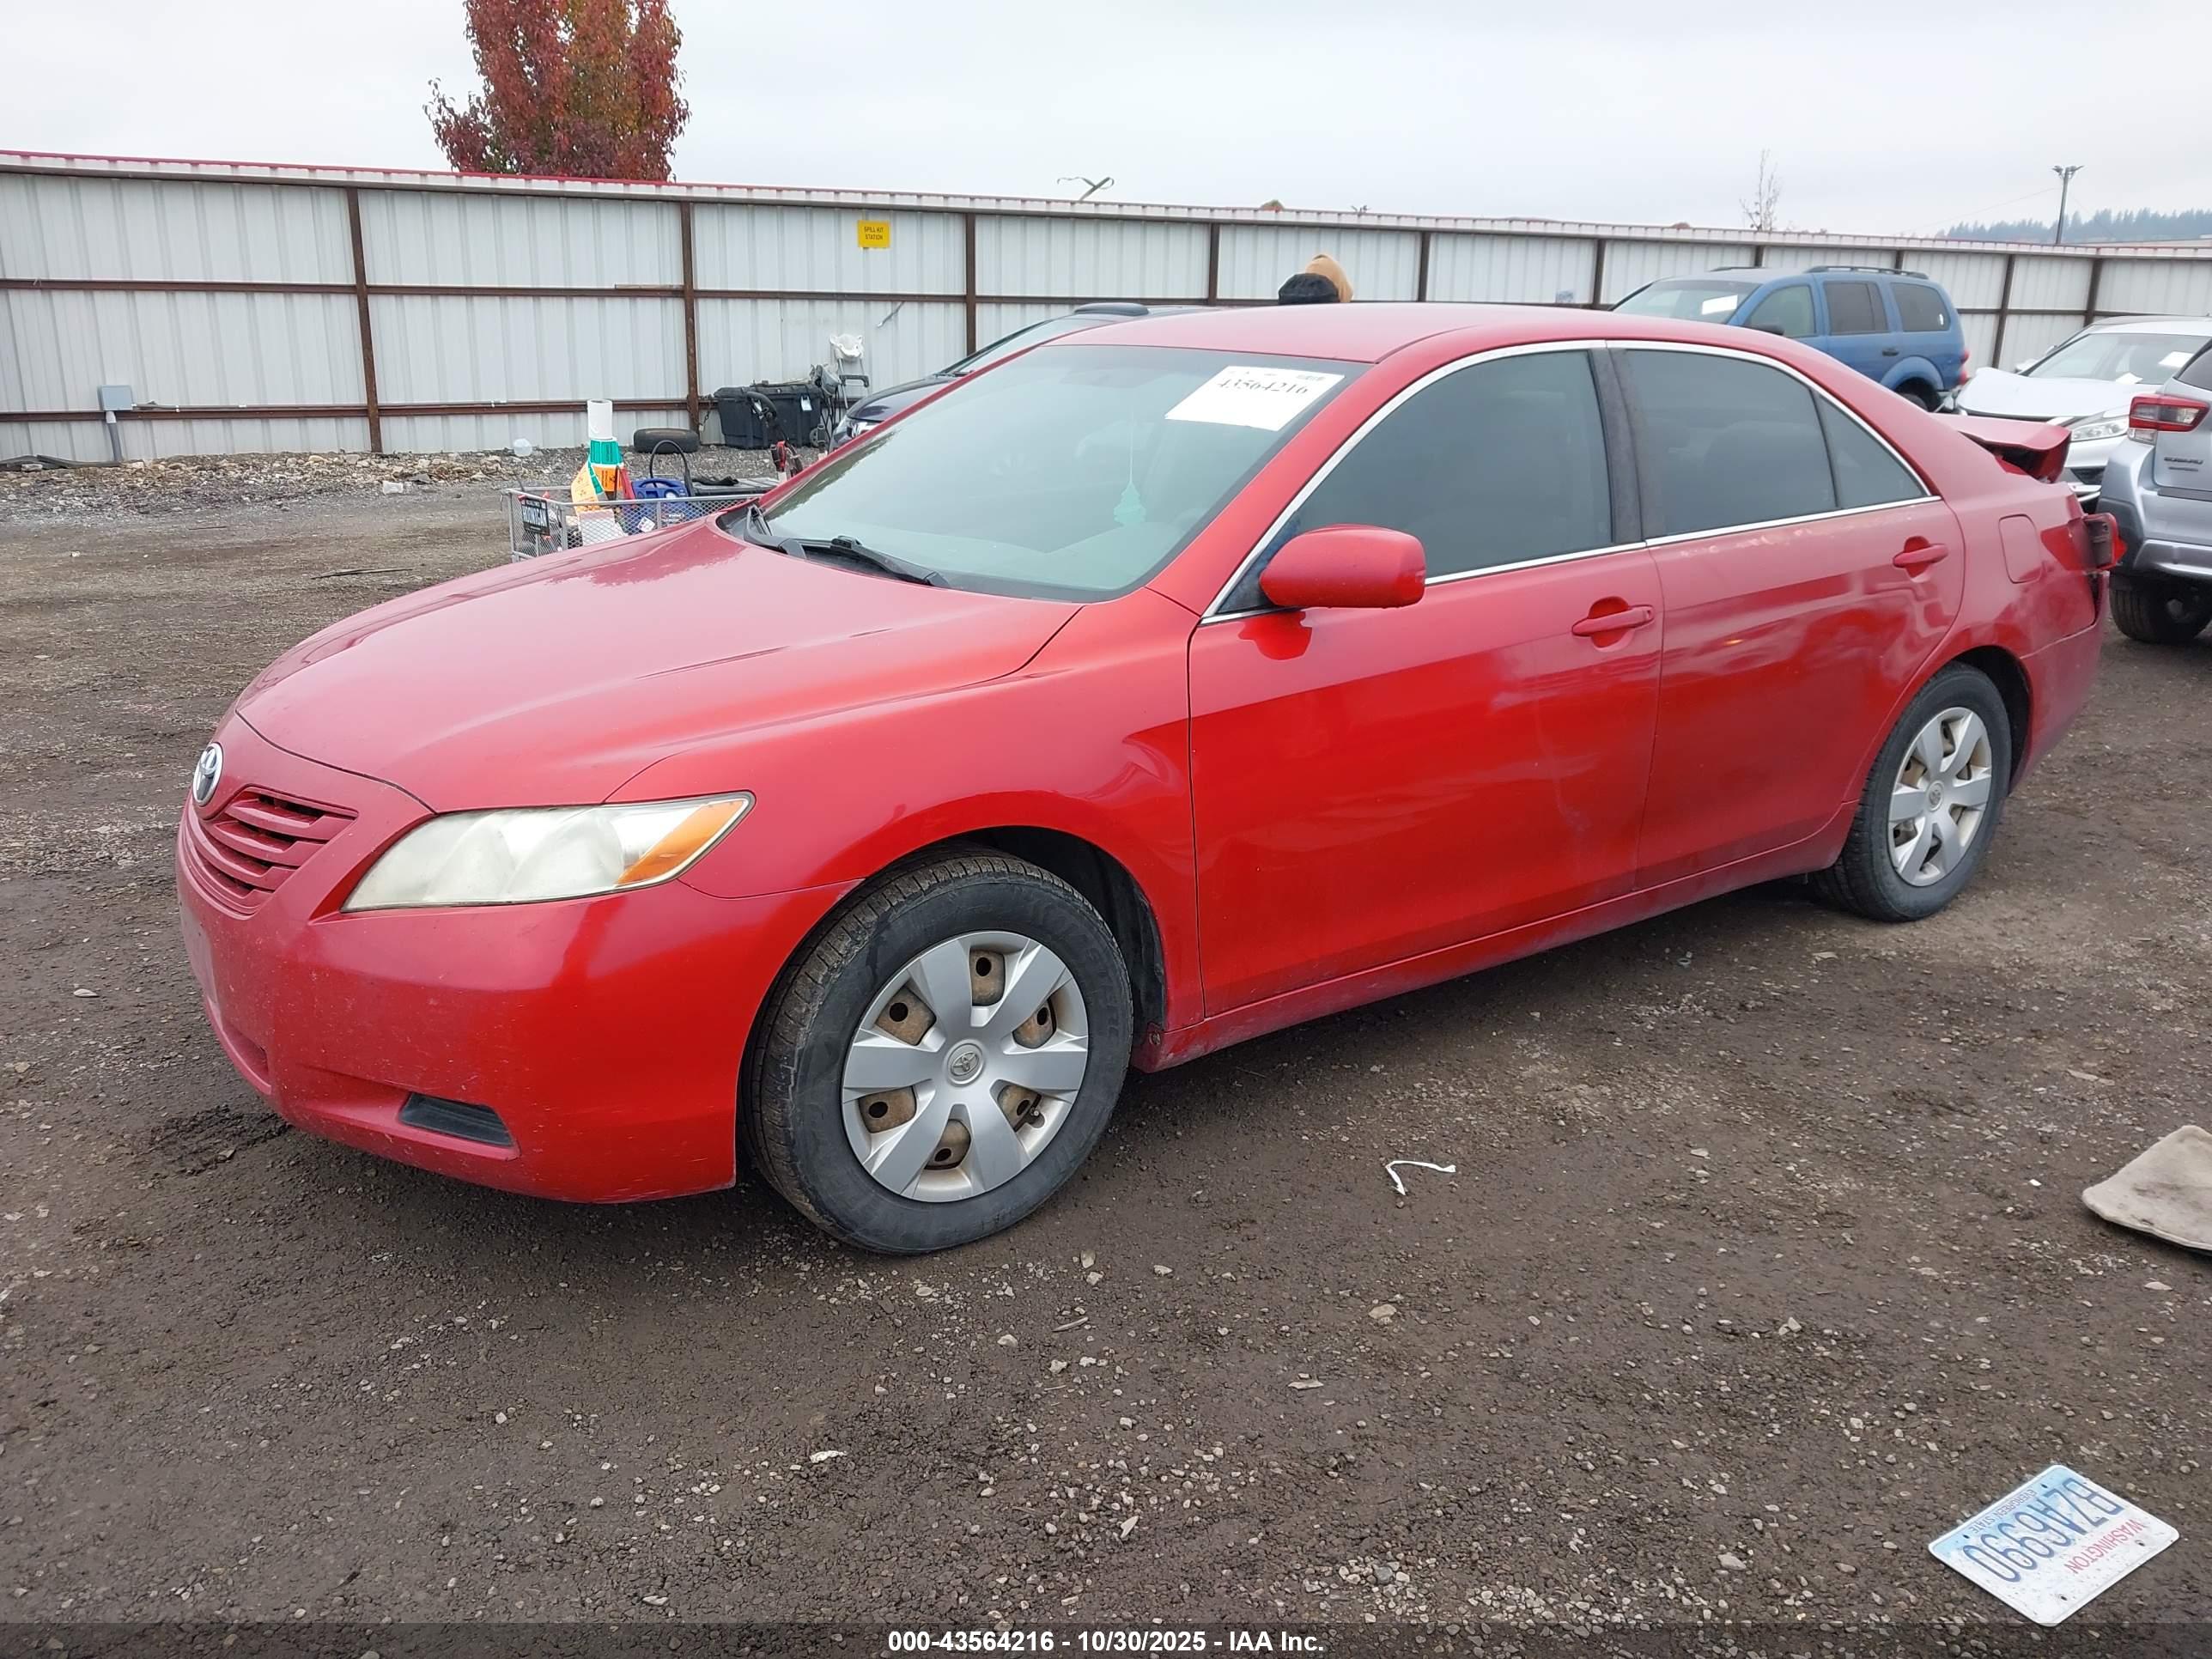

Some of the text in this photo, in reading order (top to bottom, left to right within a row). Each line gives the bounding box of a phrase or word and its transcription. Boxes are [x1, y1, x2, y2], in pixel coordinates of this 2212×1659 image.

[1217, 378, 1309, 394] 43564216
[1961, 1477, 2124, 1583] BZA6990
[1968, 1489, 2038, 1534] EVERGREEN STATE
[2063, 1518, 2147, 1575] WASHINGTON
